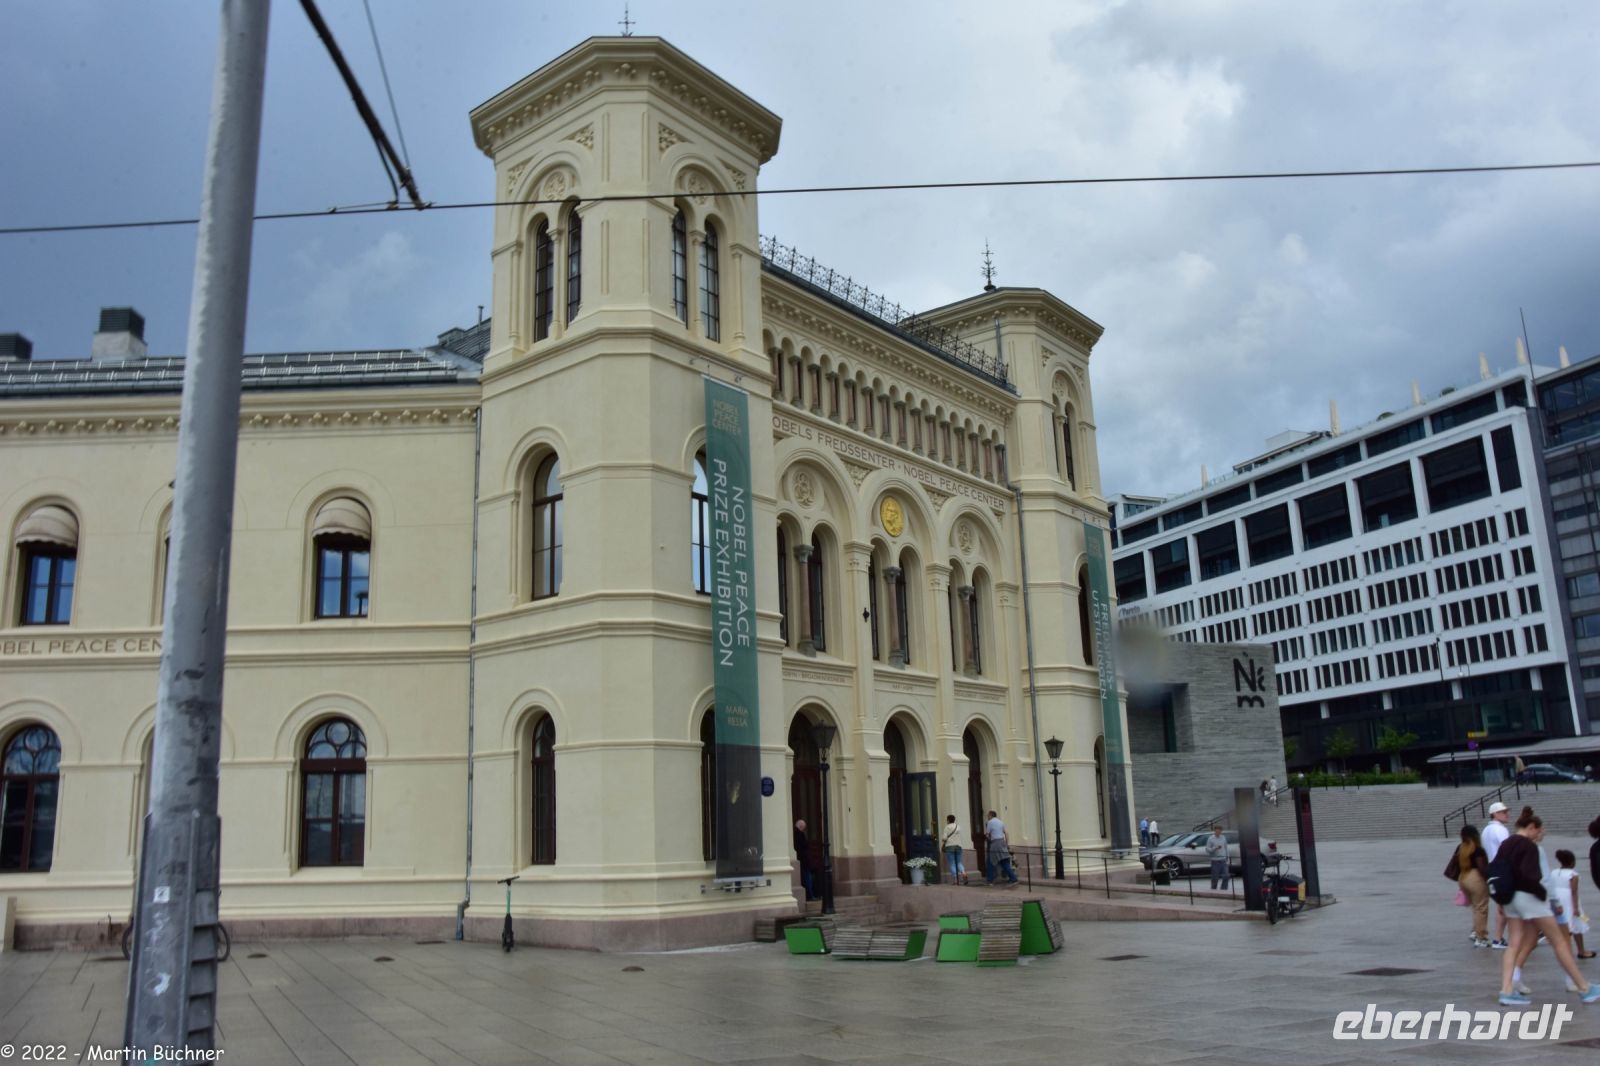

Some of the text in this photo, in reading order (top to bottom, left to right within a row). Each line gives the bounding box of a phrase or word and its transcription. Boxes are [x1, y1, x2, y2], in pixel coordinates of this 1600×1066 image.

[818, 433, 896, 470] FREDSSENTER
[903, 464, 937, 486] NOBEL
[940, 478, 970, 498] PEACE
[971, 490, 1005, 509] CENTER
[713, 458, 734, 666] PRIZE EXHIBITION
[732, 485, 750, 647] NOBEL PEACE
[0, 639, 42, 656] BEL
[48, 638, 117, 655] PEACE
[1091, 590, 1107, 699] UTSTILLINGEN
